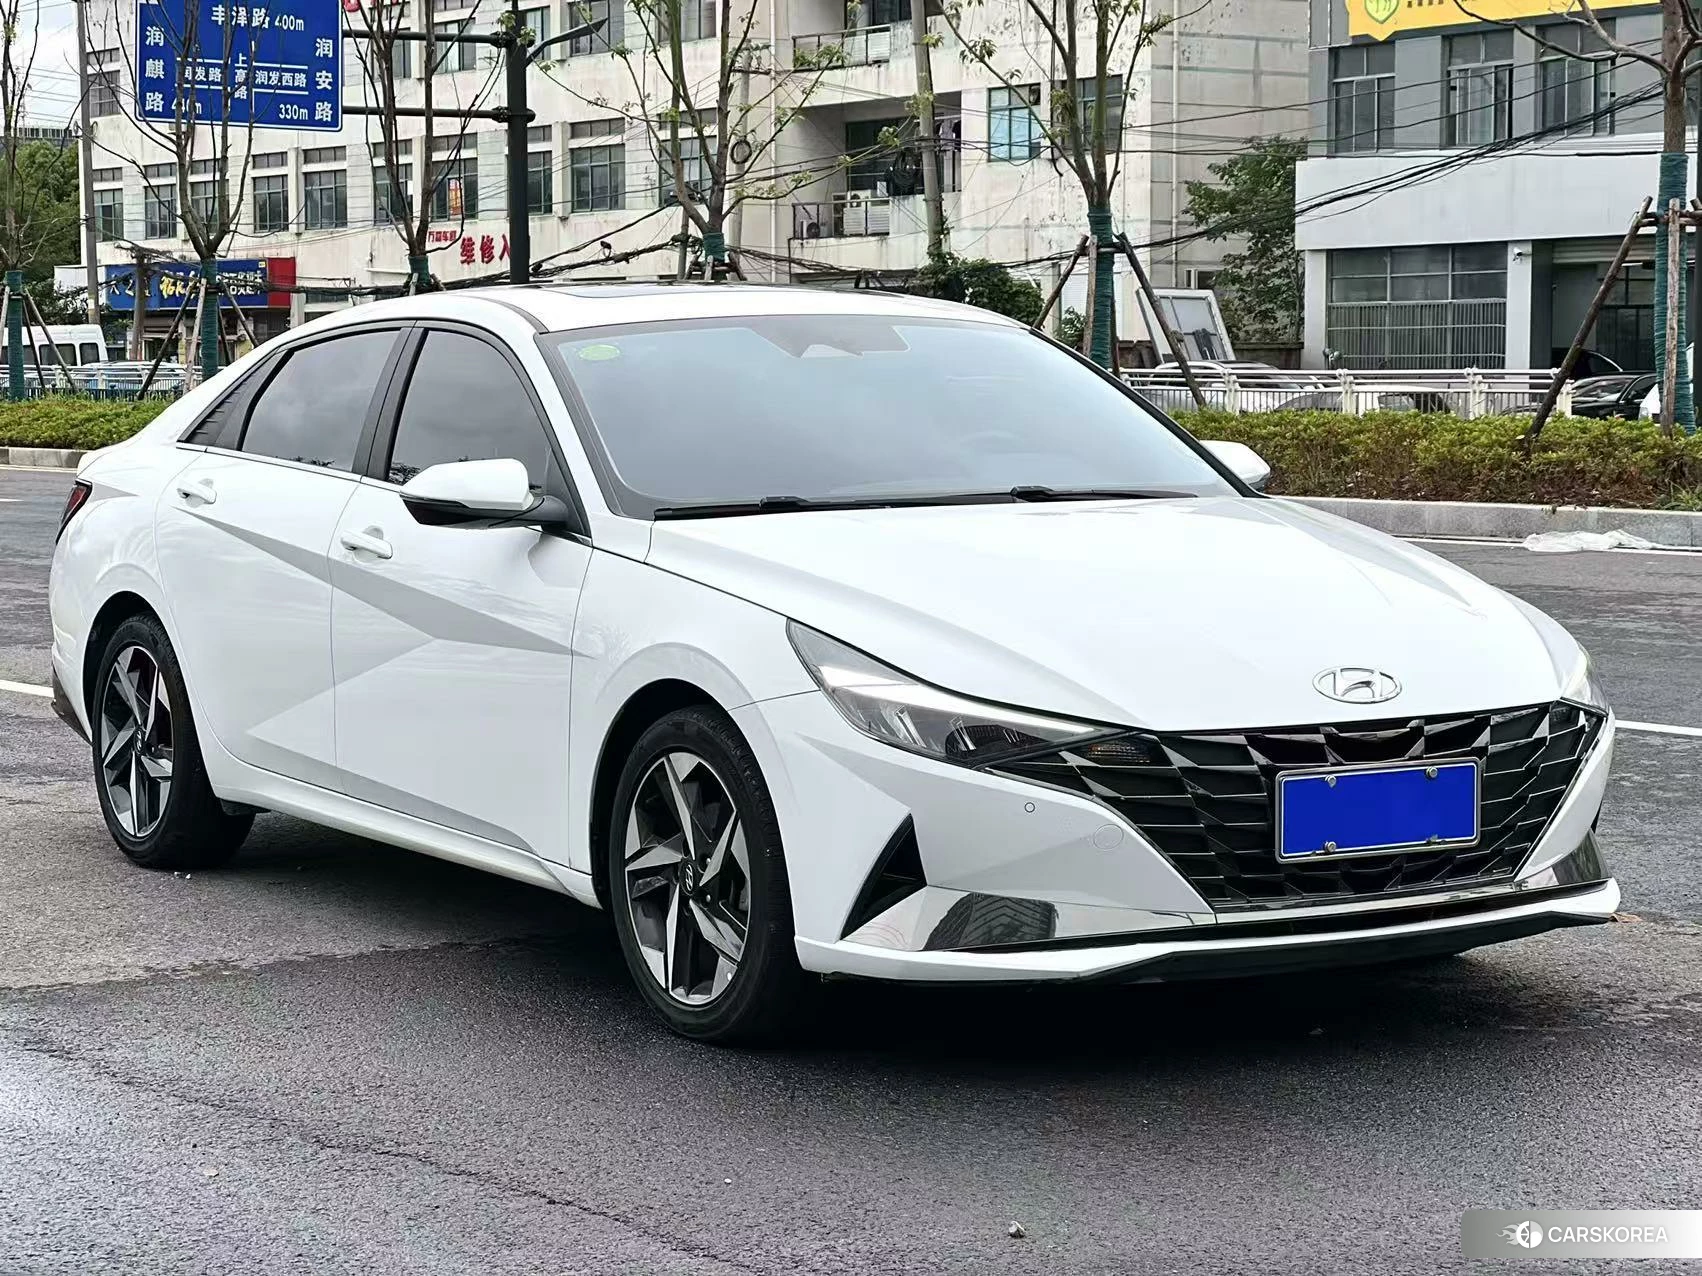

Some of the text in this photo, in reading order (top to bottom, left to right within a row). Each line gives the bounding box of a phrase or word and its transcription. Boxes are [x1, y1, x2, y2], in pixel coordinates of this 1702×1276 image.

[211, 5, 269, 28] 丰泽路
[274, 14, 305, 32] 400m
[145, 26, 164, 112] 润麒路
[234, 53, 248, 99] 上高路
[255, 70, 307, 87] 润发西路
[315, 38, 333, 121] 润安路
[278, 103, 309, 121] 330m
